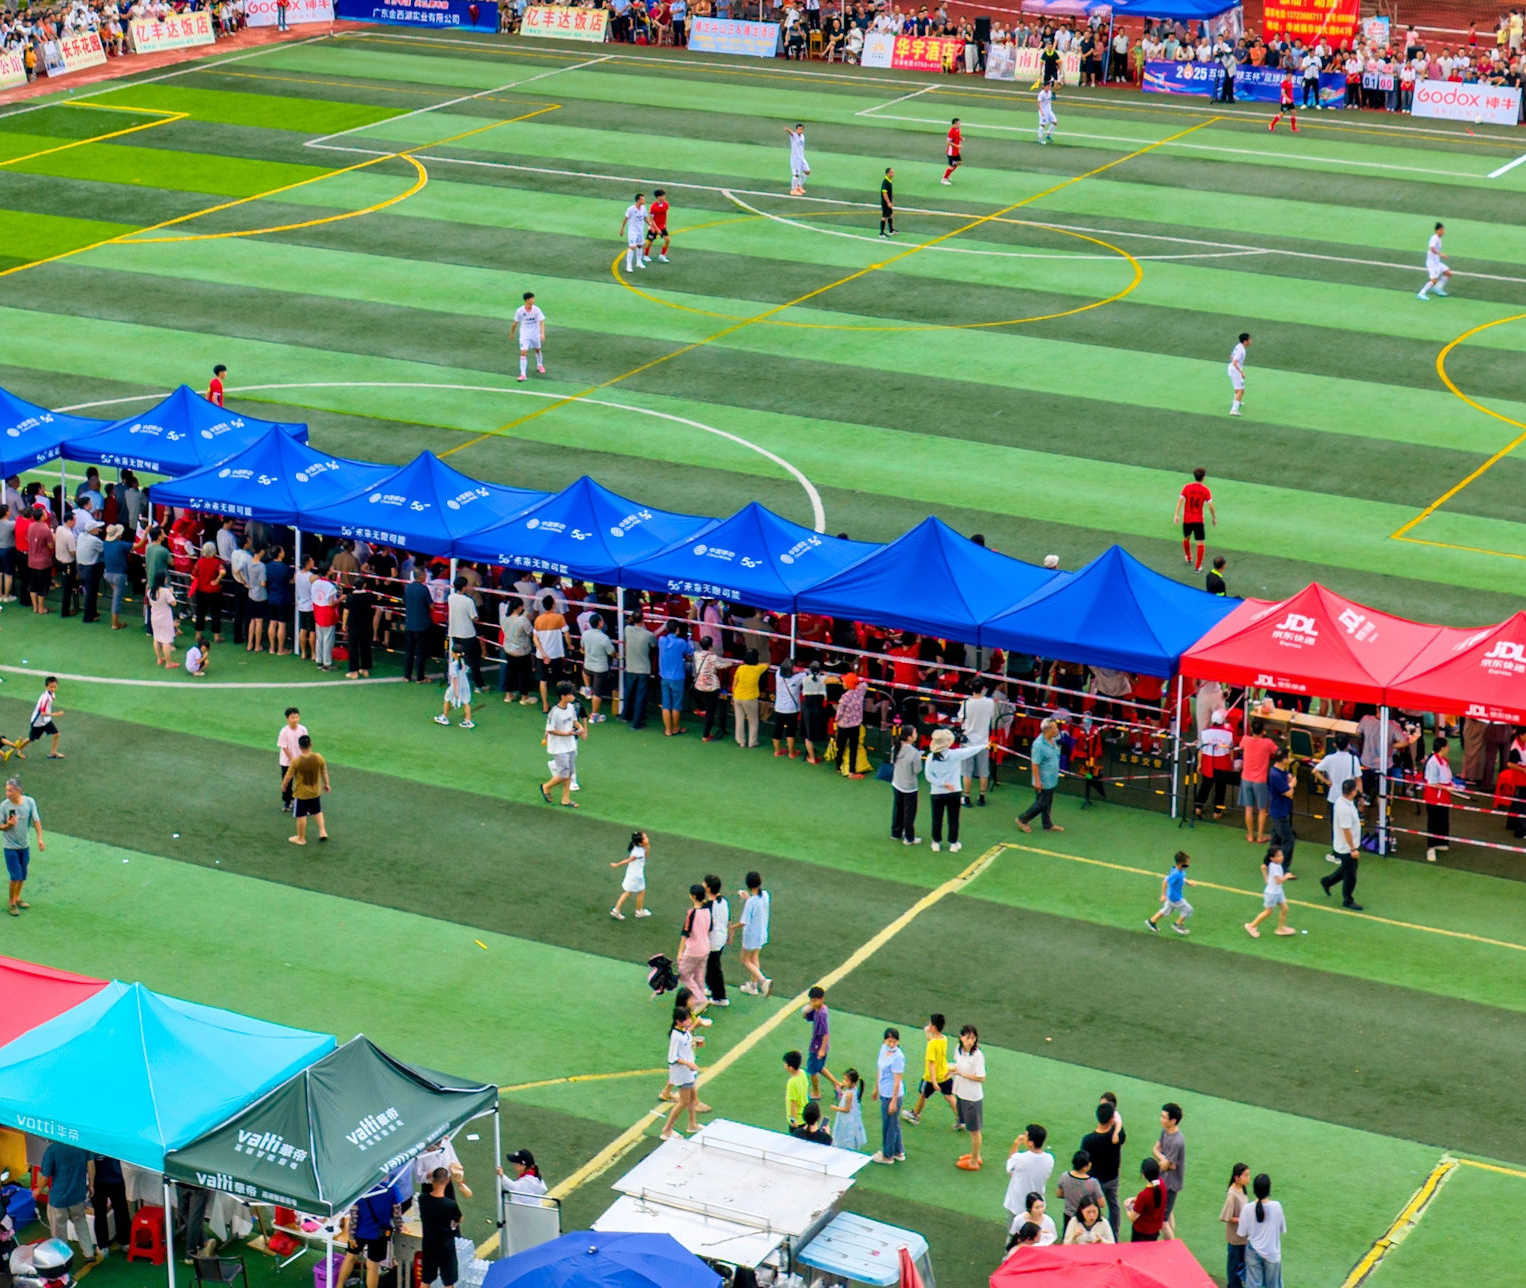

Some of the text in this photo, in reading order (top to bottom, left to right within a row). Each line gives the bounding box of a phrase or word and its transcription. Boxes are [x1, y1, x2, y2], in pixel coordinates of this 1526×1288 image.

[373, 8, 460, 24] 广东金西湖实业有限公司
[526, 8, 604, 32] 亿丰达饭店
[136, 16, 210, 42] 亿丰达饭店
[61, 36, 102, 58] 长乐花园
[896, 38, 956, 62] 华宇酒店
[1417, 88, 1516, 110] Godox 神牛
[1276, 613, 1319, 636] JDL
[1272, 630, 1315, 646] 京东快递
[1480, 658, 1526, 673] 京东快递
[1254, 674, 1276, 687] JDL
[1465, 704, 1488, 718] JDL
[345, 1115, 379, 1145] vatti
[238, 1129, 307, 1162] vatti 華帝
[196, 1172, 233, 1192] vatti
